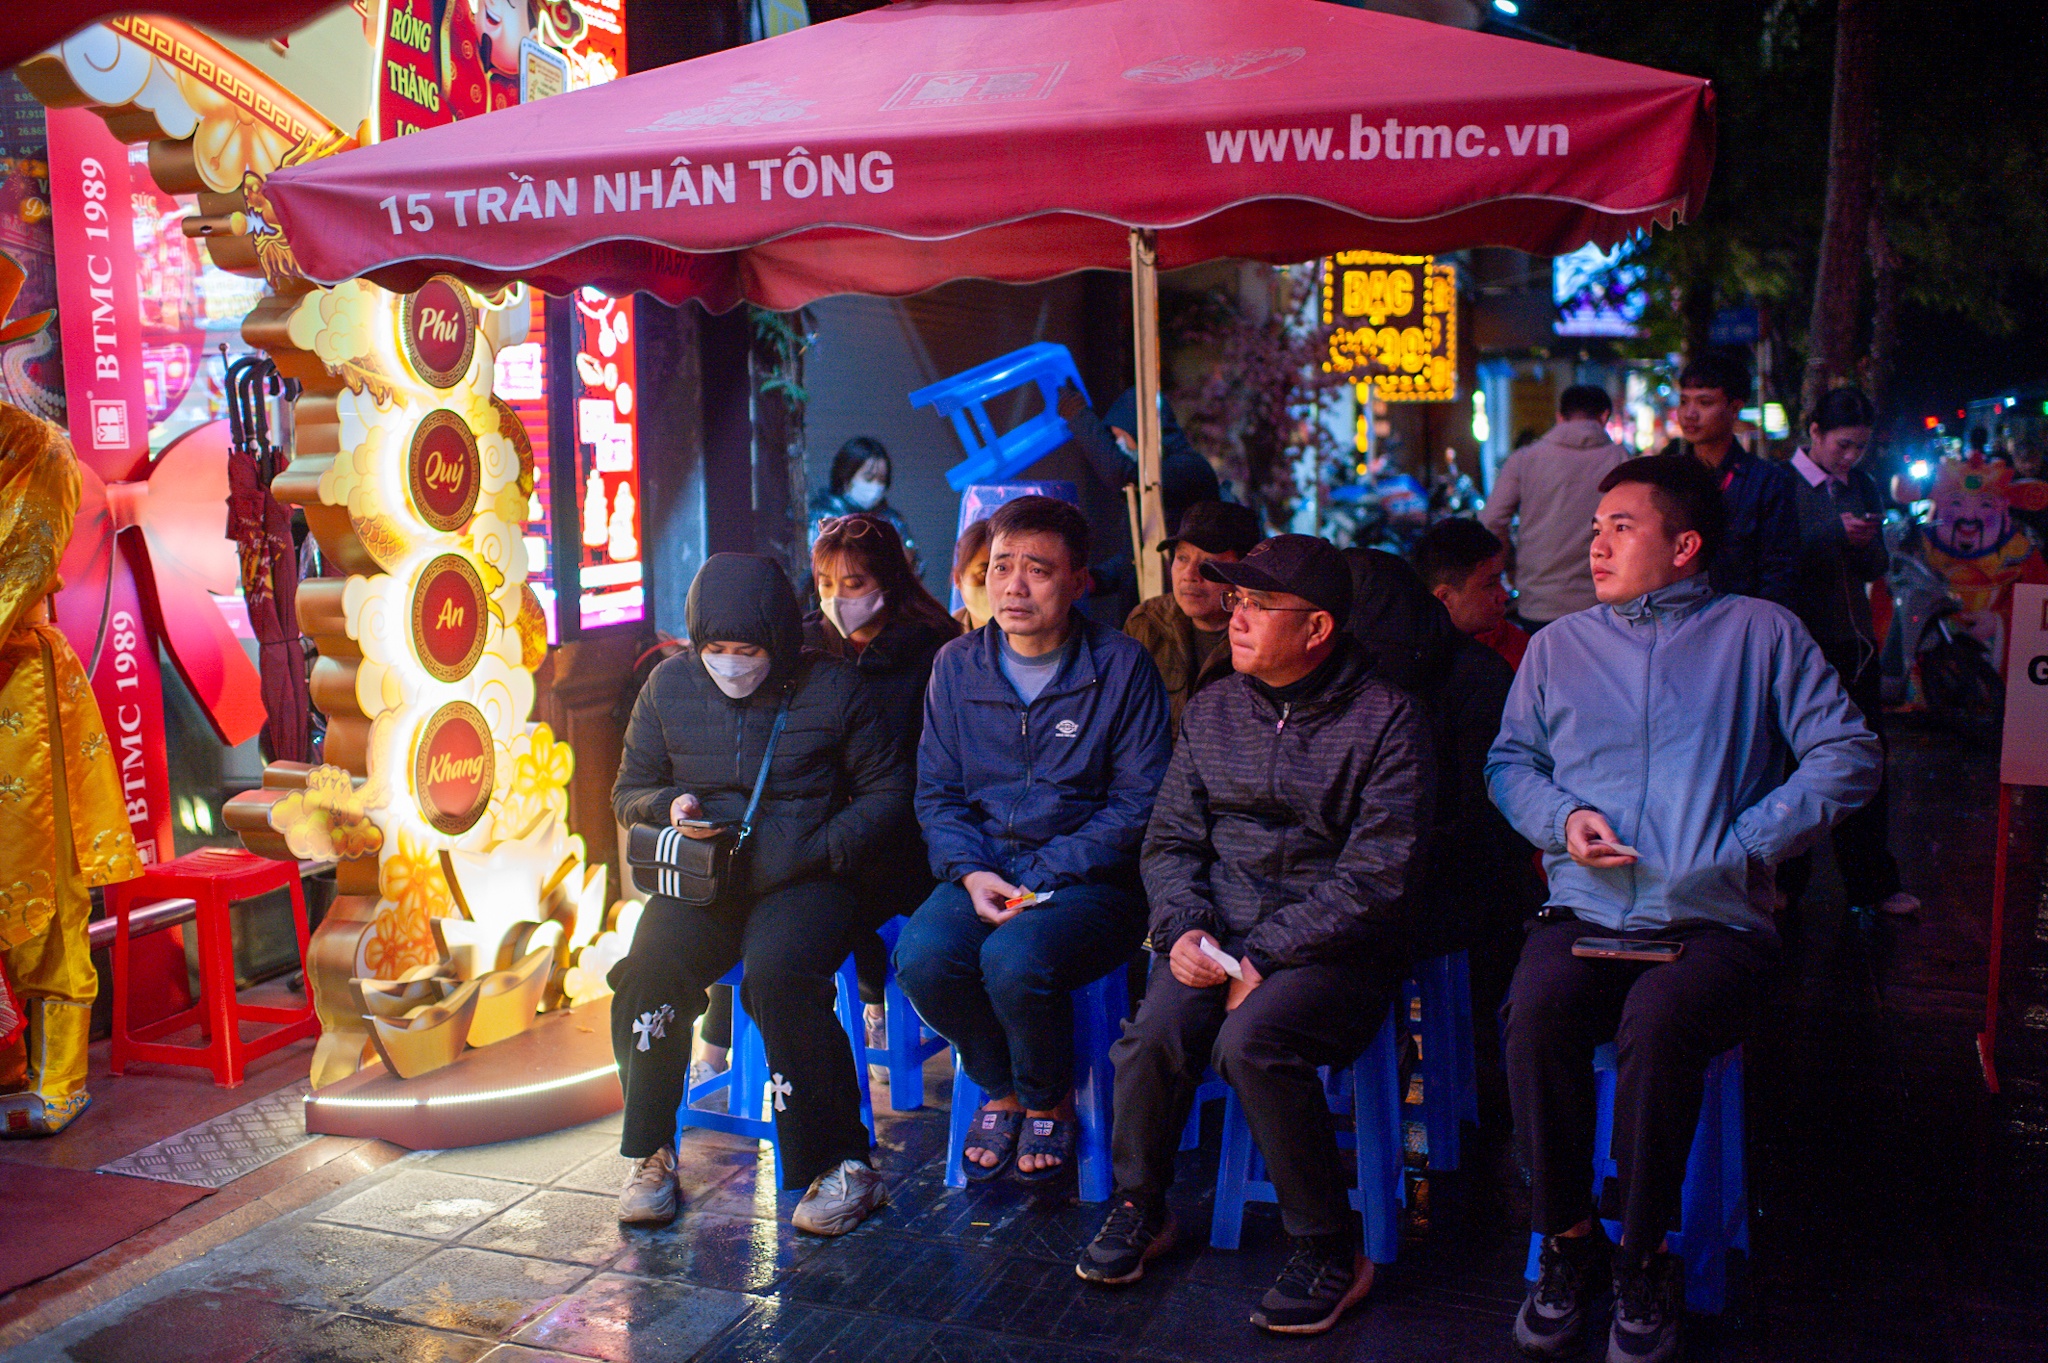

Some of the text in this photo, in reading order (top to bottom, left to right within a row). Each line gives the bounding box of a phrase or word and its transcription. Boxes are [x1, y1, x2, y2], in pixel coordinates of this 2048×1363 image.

[387, 60, 440, 112] THĂNG
[1205, 113, 1570, 163] www.btmc.vn
[379, 146, 894, 235] 15 TRẦN NHÂN TÔNG
[80, 157, 120, 382] BTMC 1989
[418, 307, 459, 343] Phú
[425, 451, 465, 493] Quý
[436, 598, 464, 630] An
[113, 610, 149, 824] BTMC 1989
[427, 752, 485, 786] Khang
